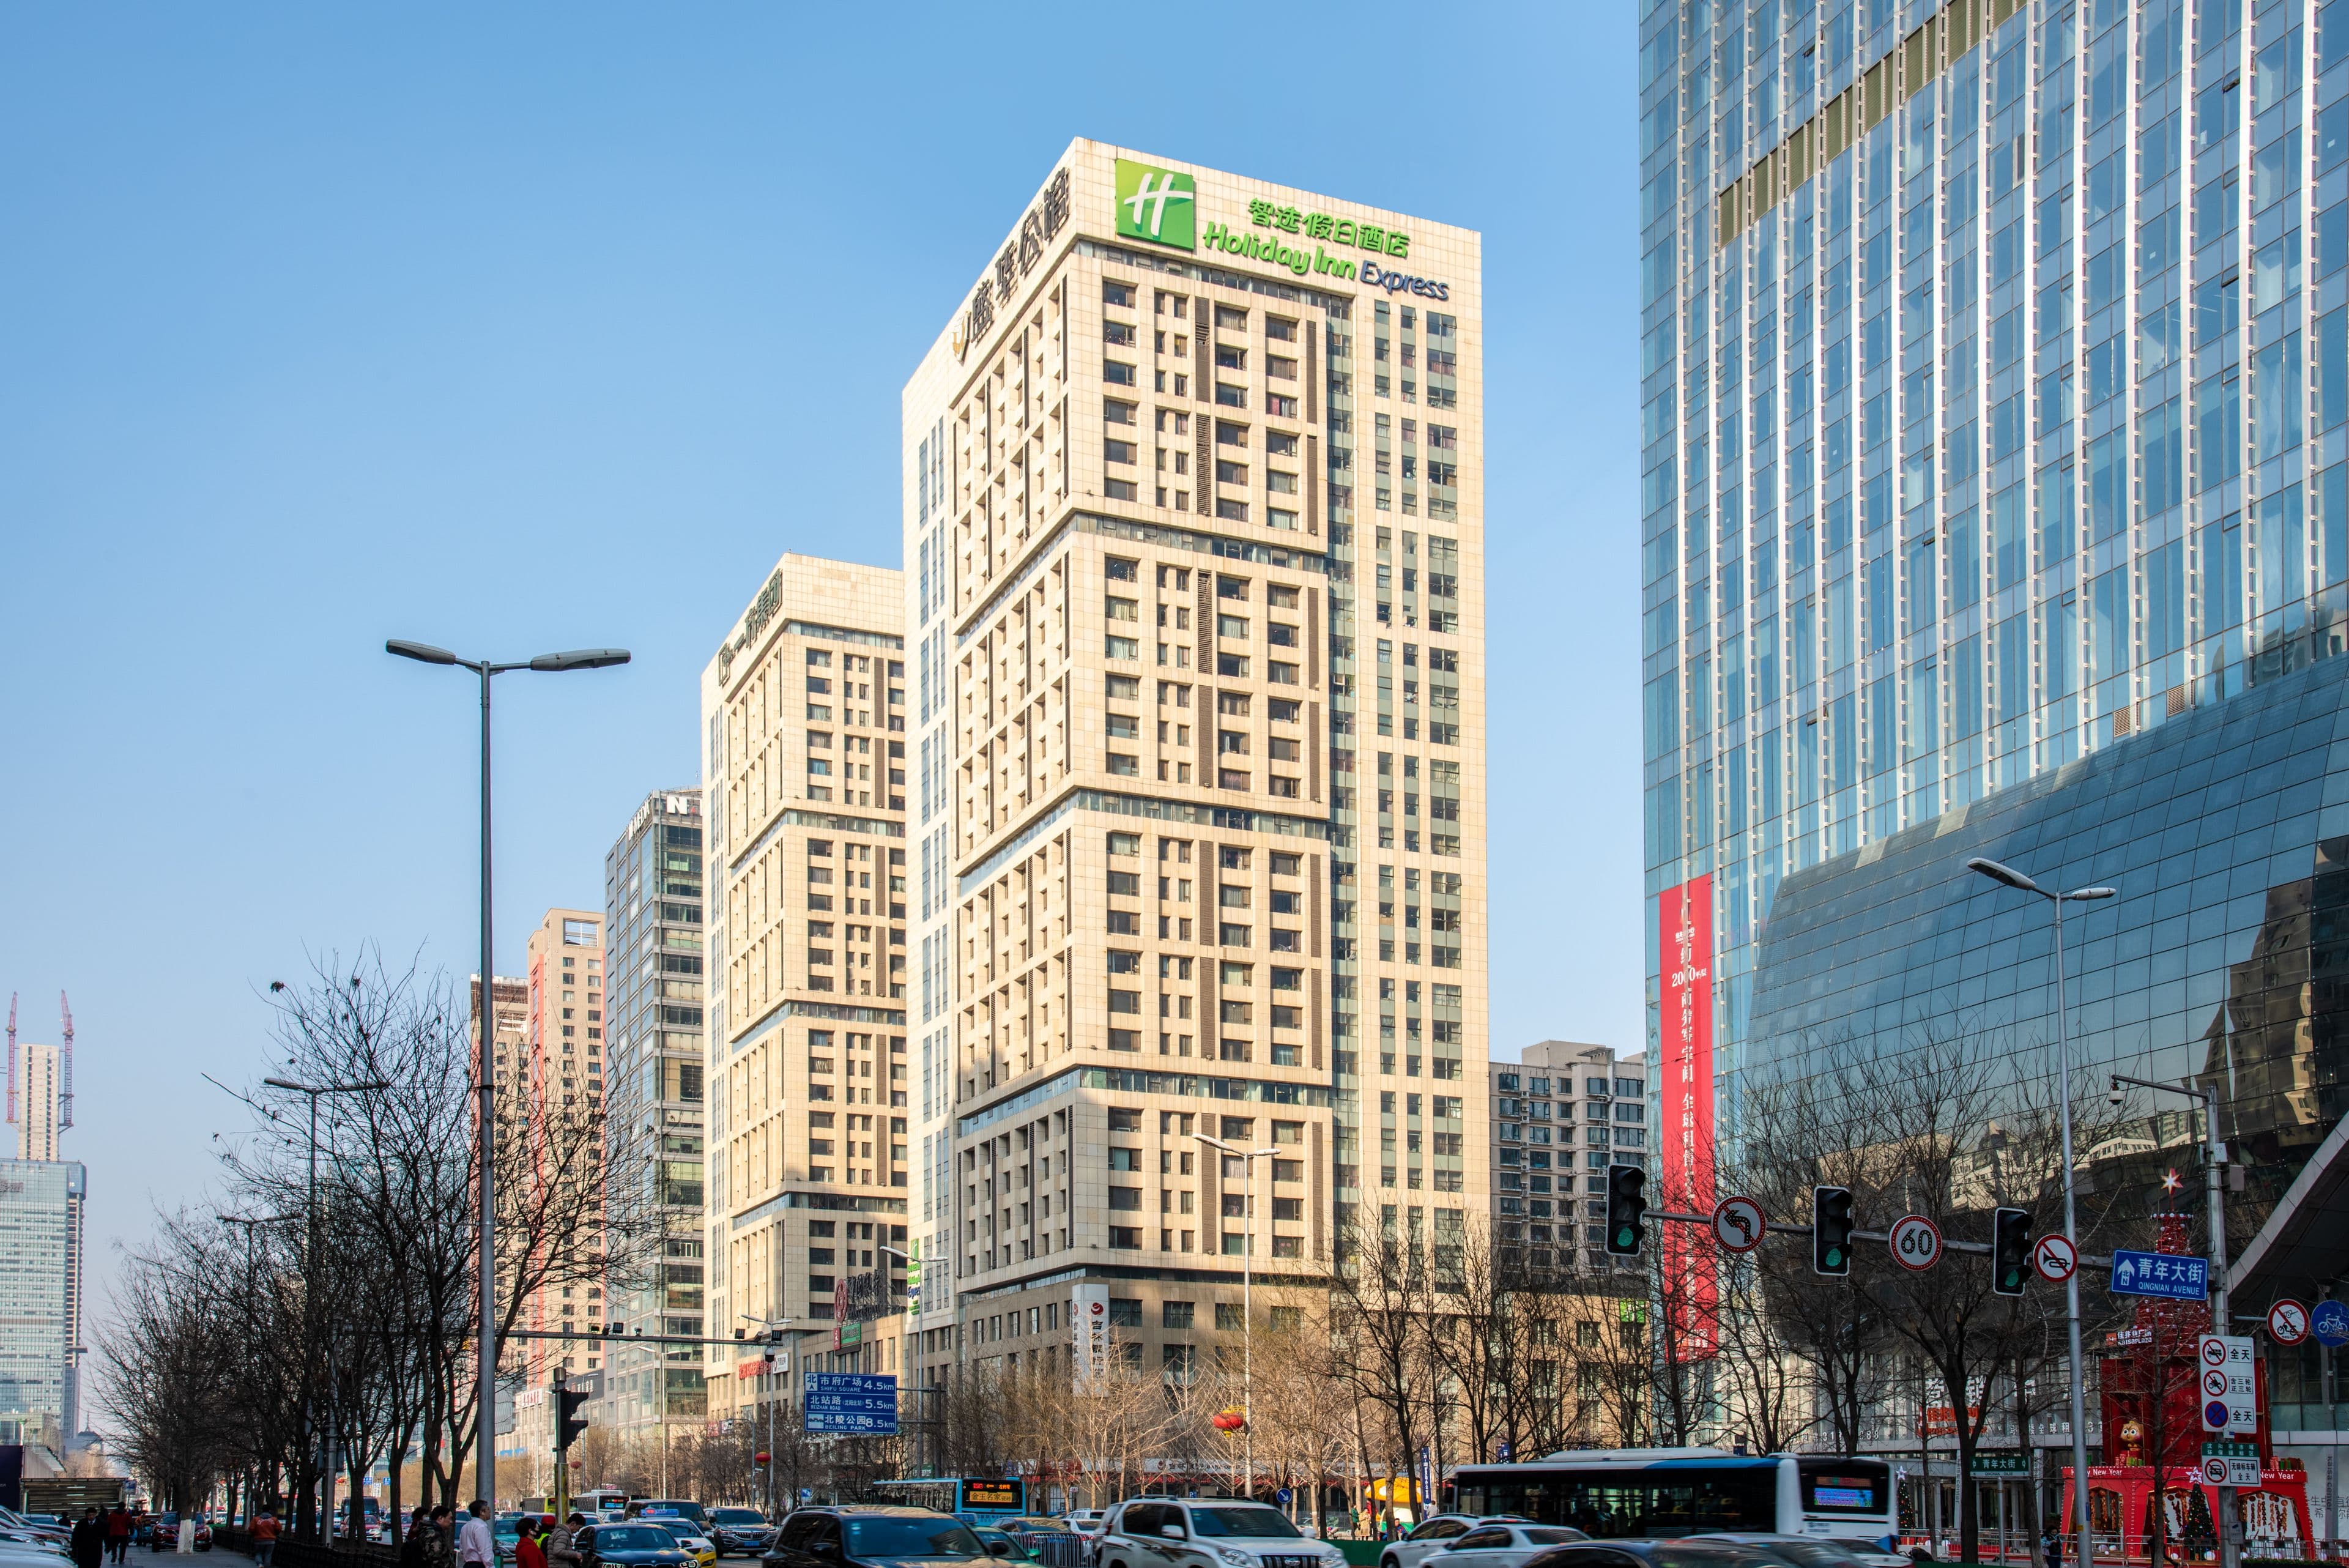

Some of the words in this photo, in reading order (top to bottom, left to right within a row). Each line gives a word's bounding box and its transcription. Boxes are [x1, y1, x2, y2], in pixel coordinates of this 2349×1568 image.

[1248, 197, 1411, 258] 智选假日酒店
[1203, 220, 1310, 275] Holiday
[1314, 245, 1356, 280] Inn
[1360, 259, 1450, 300] Express
[1901, 1227, 1932, 1255] 60
[2138, 1258, 2203, 1284] 青年大街
[2138, 1282, 2170, 1292] QINGNIAN
[2172, 1285, 2200, 1295] AVENUE
[2230, 1348, 2250, 1360] 全天
[807, 1374, 817, 1383] 北
[820, 1376, 862, 1387] 市府广场
[864, 1380, 894, 1391] 4.5km
[811, 1395, 841, 1405] 北站路
[865, 1399, 894, 1410] 5.5km
[825, 1414, 866, 1425] 北陵公园
[866, 1418, 895, 1428] 8.5km
[2232, 1410, 2252, 1422] 全天
[1983, 1458, 2016, 1469] 青年大街
